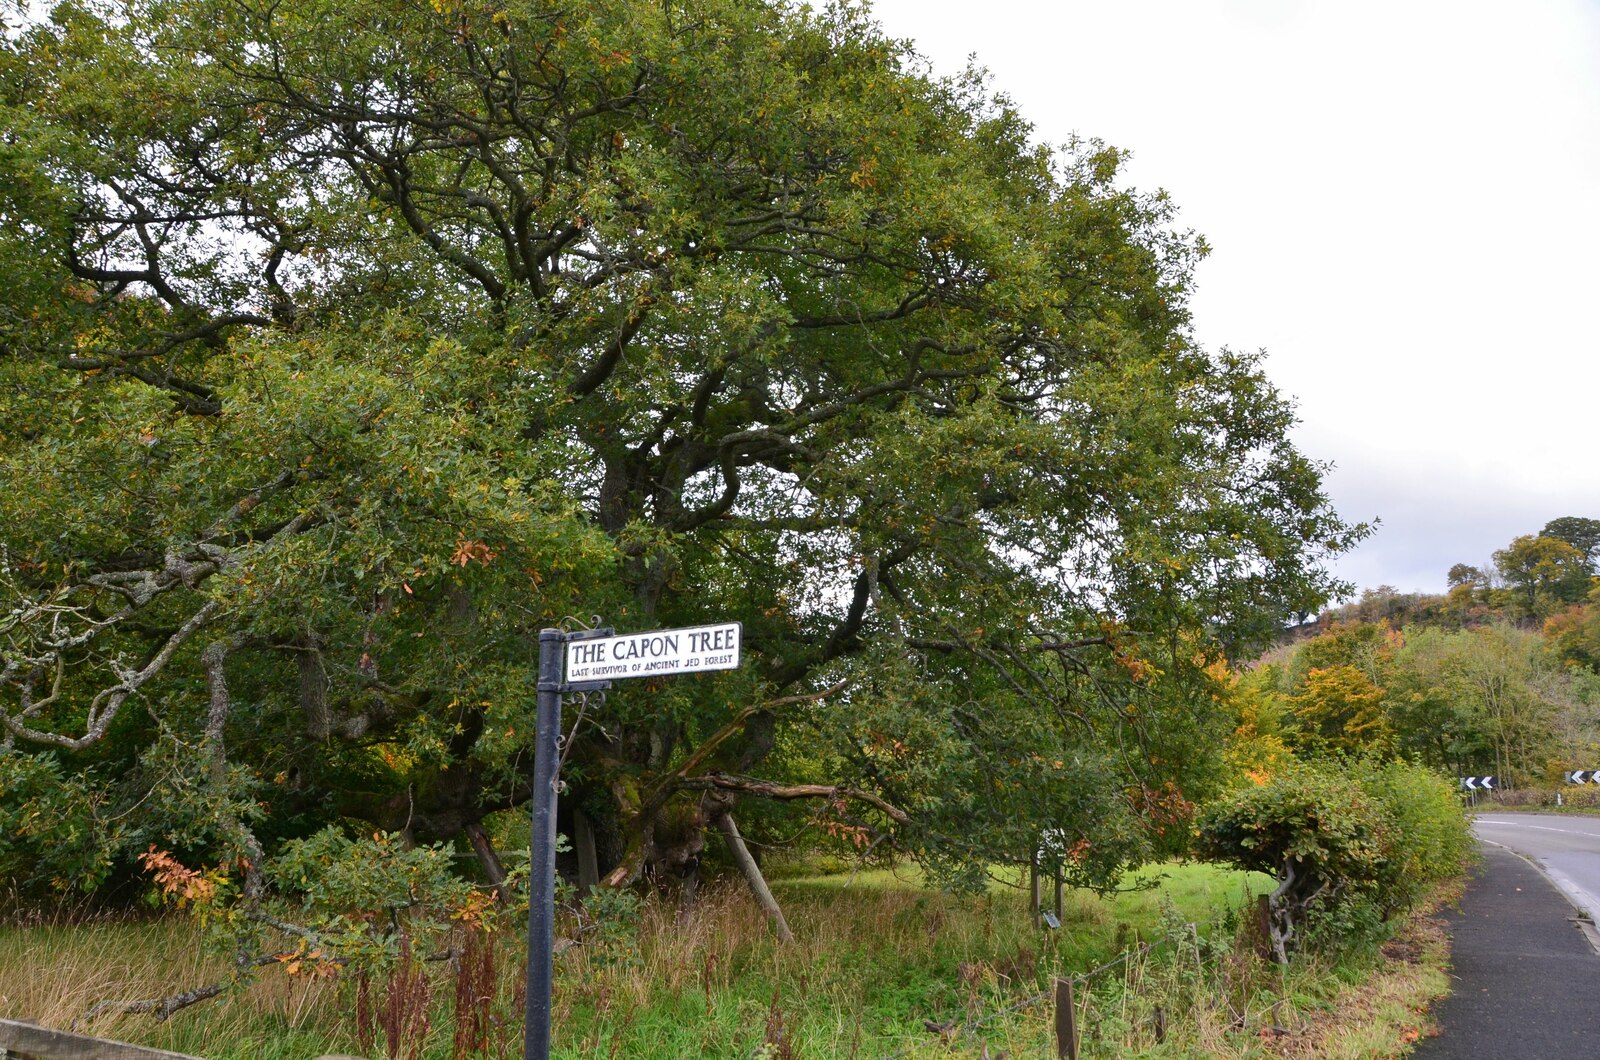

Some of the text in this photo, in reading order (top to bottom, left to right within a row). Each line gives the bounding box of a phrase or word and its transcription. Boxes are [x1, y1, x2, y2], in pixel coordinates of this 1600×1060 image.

[572, 628, 735, 664] THE CAPON TREE
[571, 655, 733, 677] LAST SURVIVOR OF ANCIENT JED FOREST
